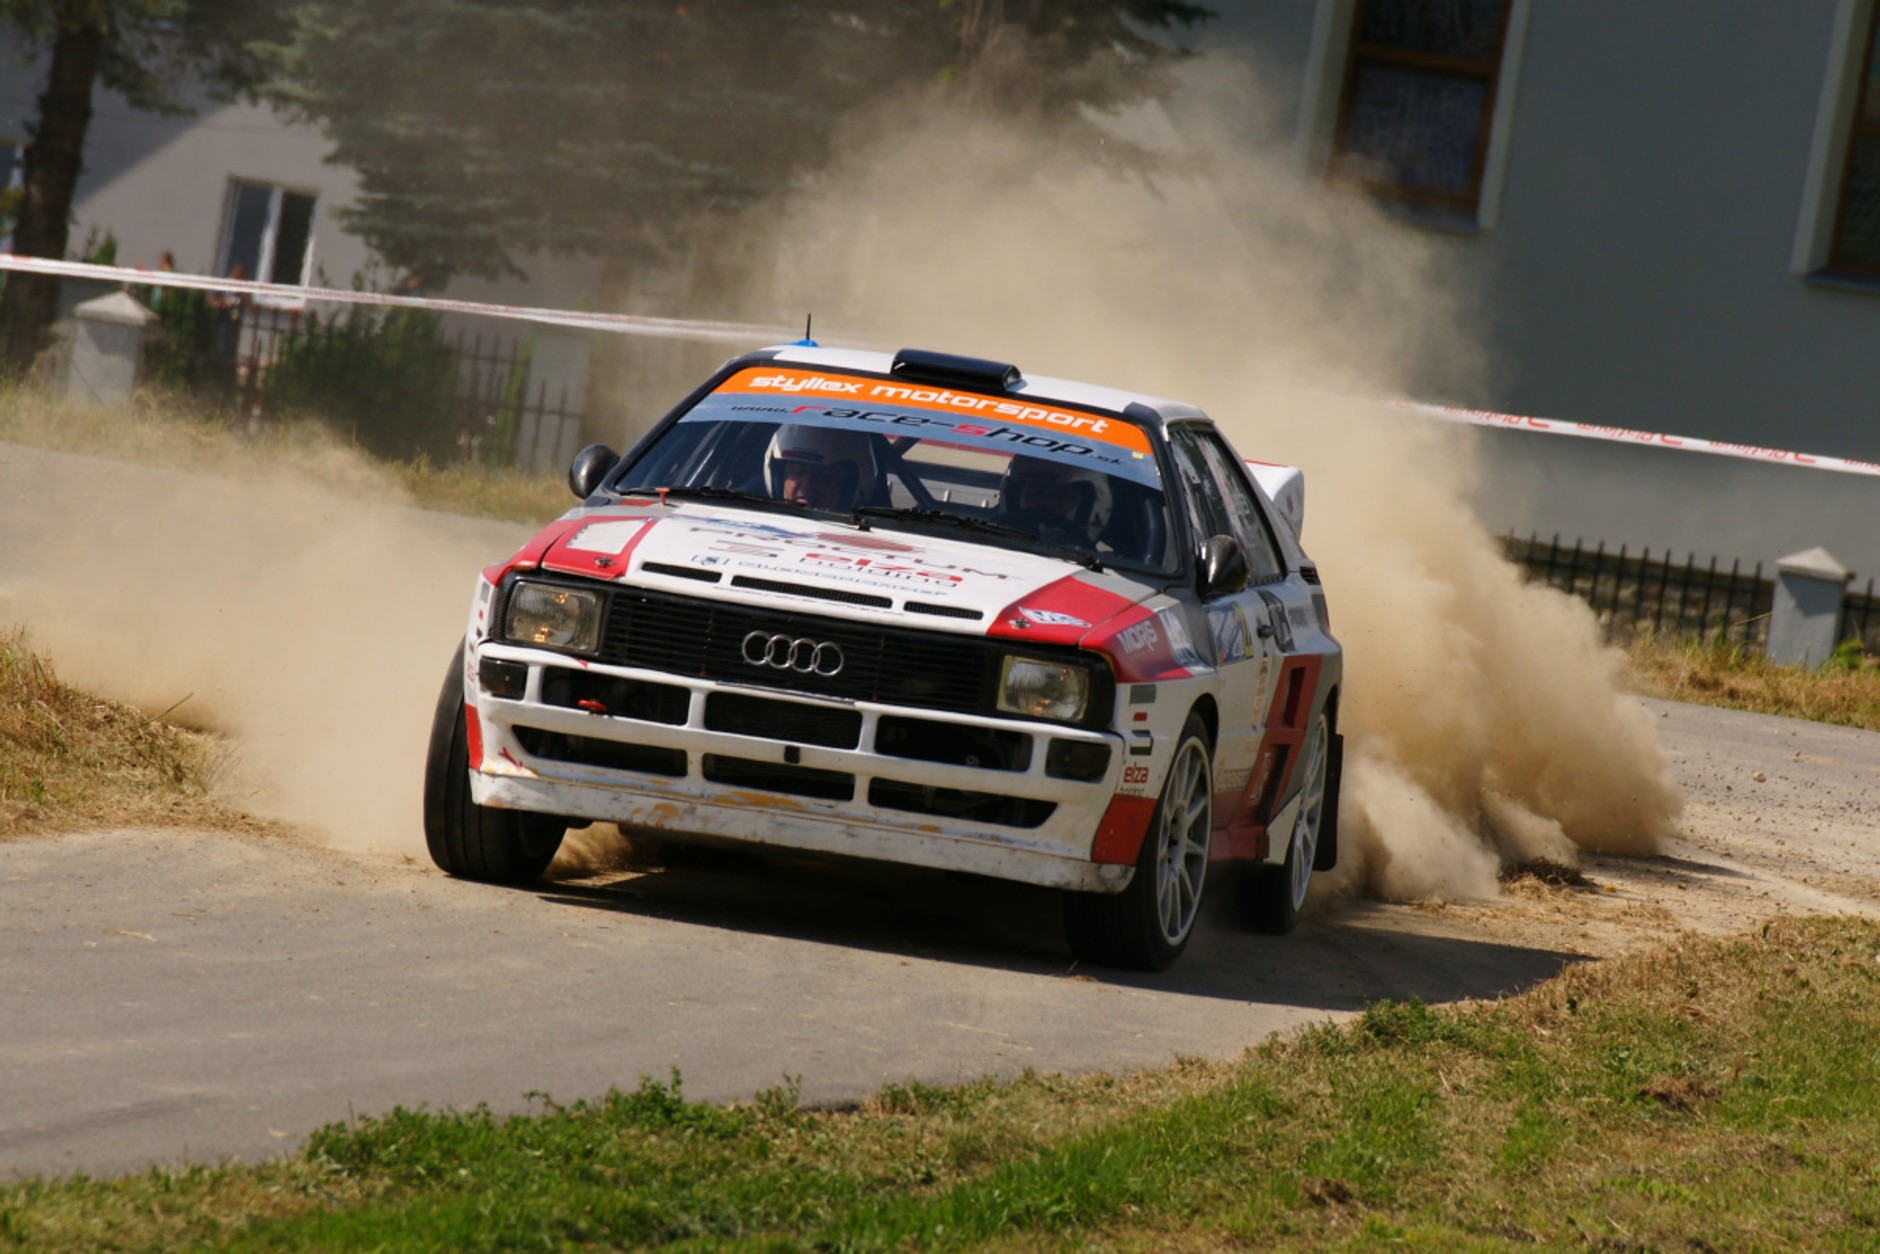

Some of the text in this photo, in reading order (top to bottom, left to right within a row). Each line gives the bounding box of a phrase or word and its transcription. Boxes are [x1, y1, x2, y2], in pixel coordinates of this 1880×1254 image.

[748, 374, 1110, 434] styllex motorsport
[1123, 761, 1149, 783] elza
